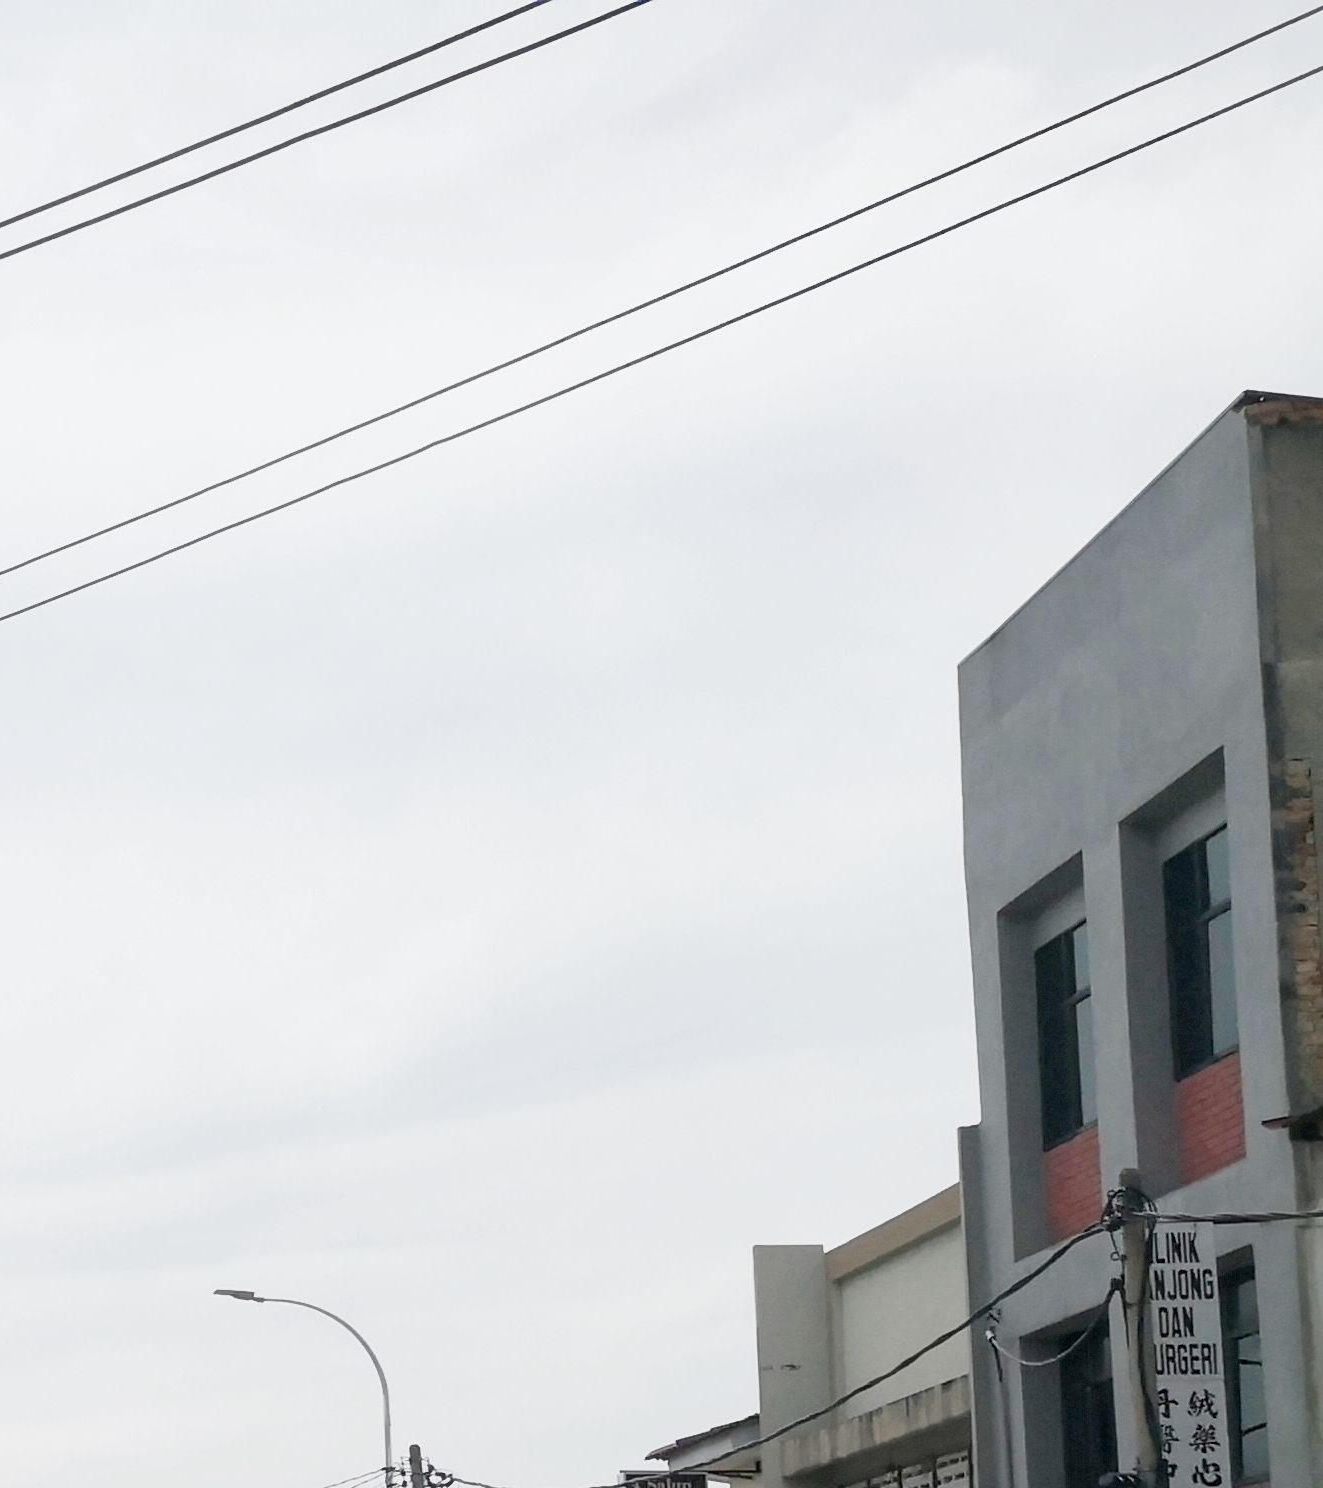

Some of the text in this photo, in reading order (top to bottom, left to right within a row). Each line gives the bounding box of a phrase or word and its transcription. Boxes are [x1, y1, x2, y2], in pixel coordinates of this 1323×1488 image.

[1151, 1232, 1200, 1264] LINIK
[1152, 1269, 1214, 1300] NJONG
[1159, 1307, 1195, 1338] DAN
[1155, 1343, 1218, 1375] URGERI
